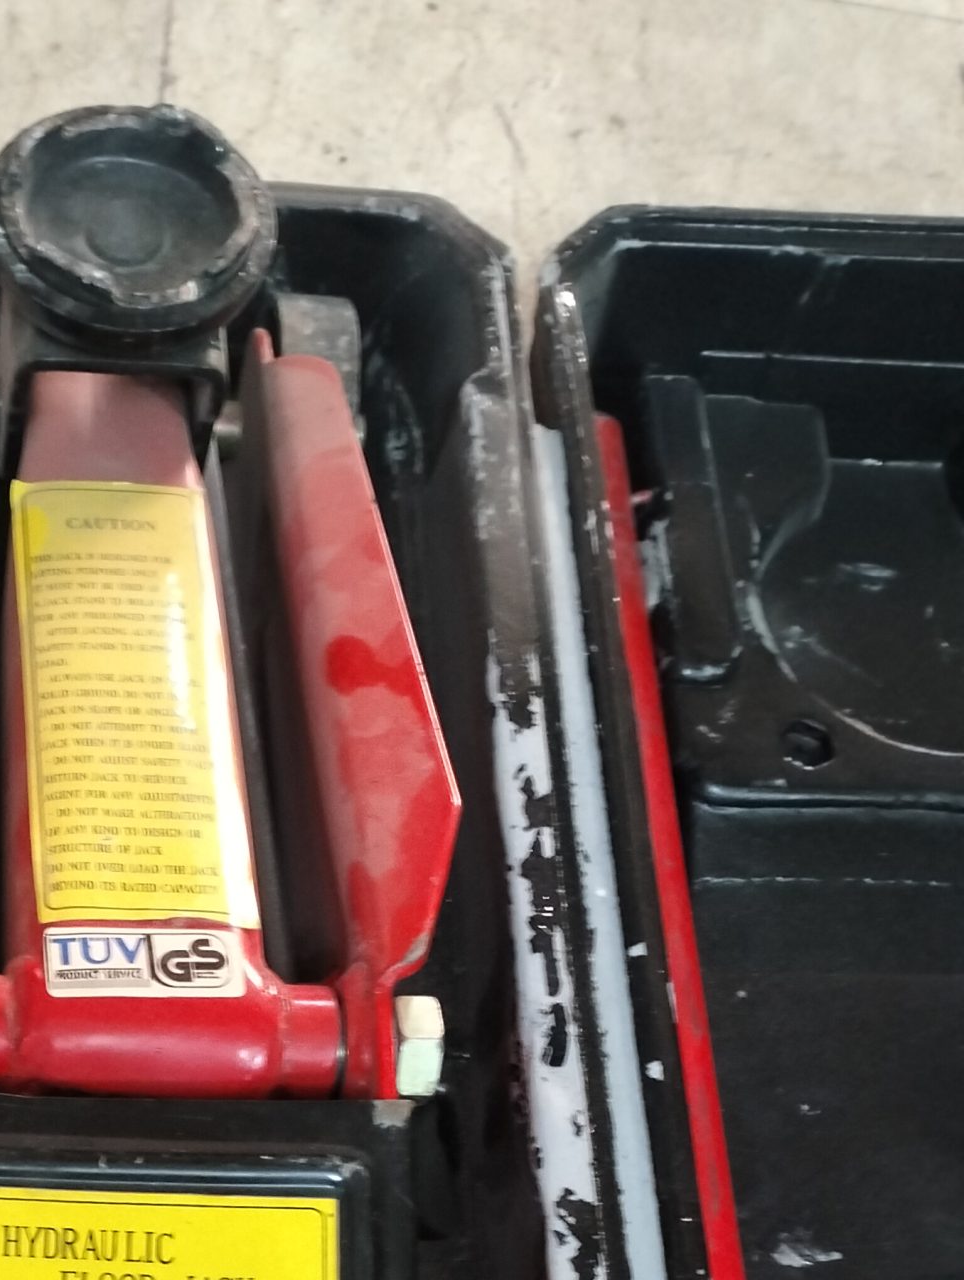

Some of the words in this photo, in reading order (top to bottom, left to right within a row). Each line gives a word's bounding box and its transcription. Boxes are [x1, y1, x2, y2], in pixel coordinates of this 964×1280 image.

[65, 517, 157, 531] CAUTION
[160, 938, 226, 982] GS
[1, 1224, 175, 1265] HYDRAULIC
